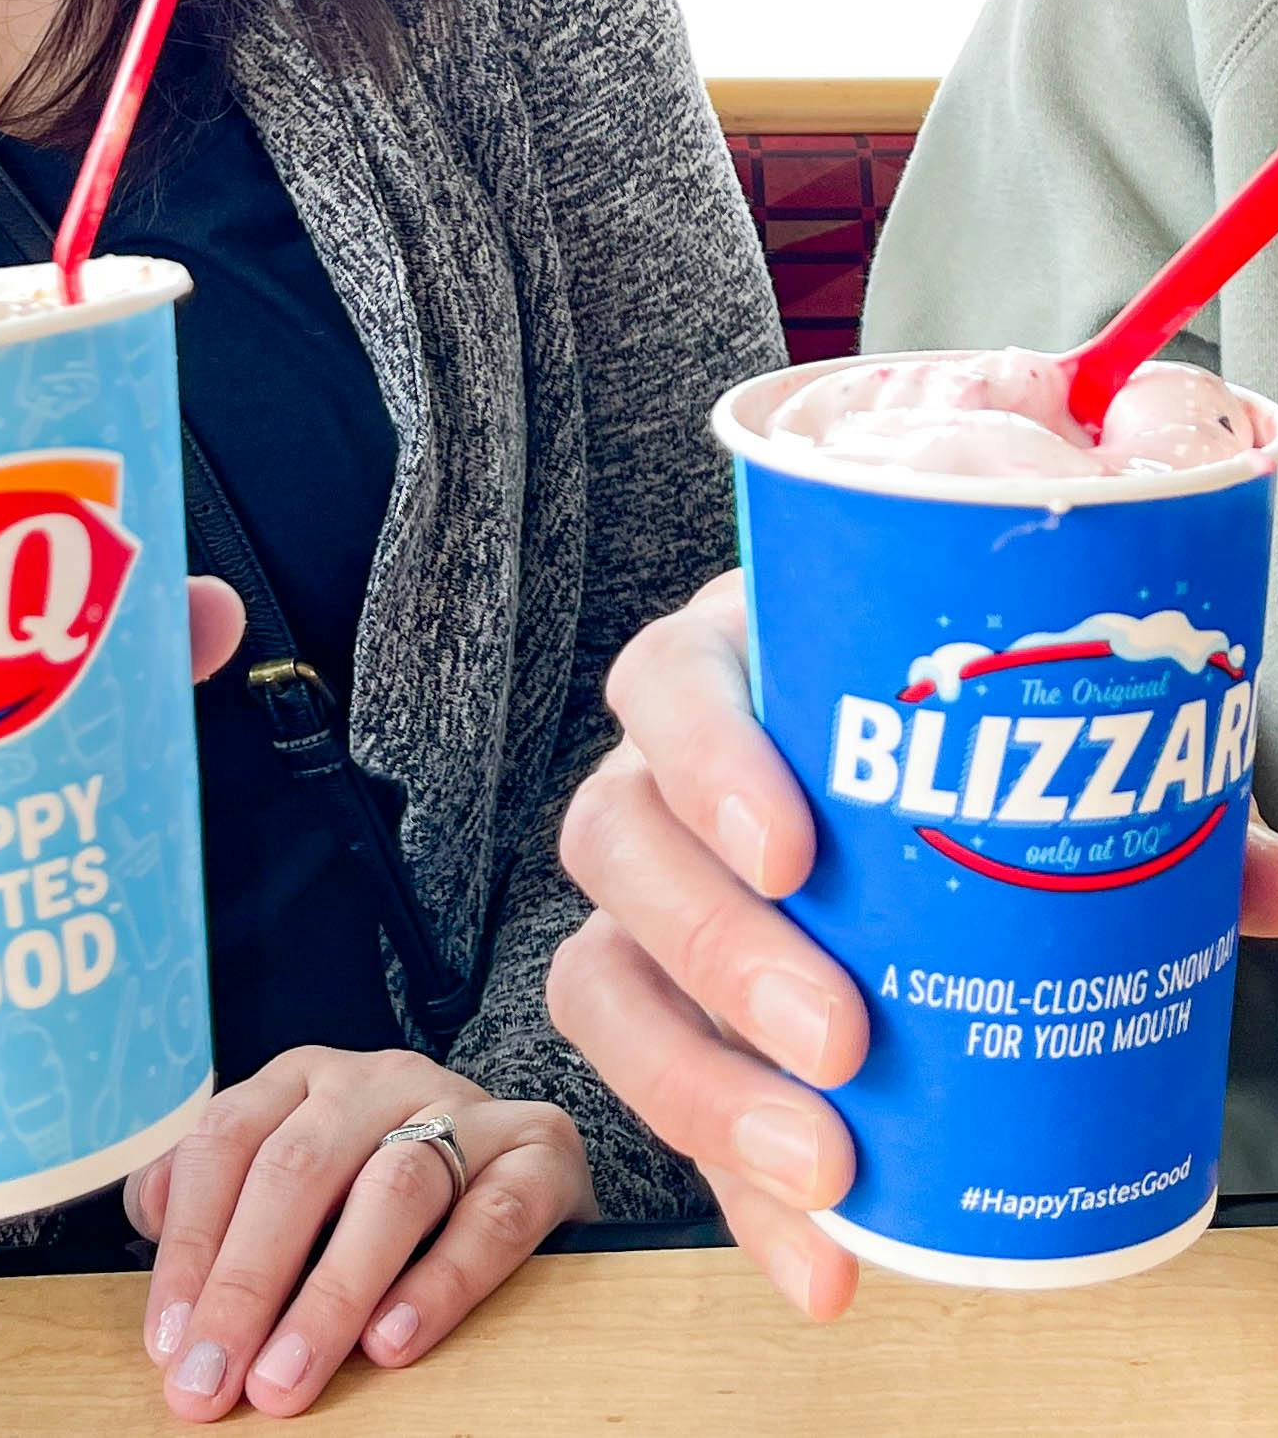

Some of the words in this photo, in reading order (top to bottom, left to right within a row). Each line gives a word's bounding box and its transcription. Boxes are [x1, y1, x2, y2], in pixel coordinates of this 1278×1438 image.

[1021, 678, 1062, 706] The
[1072, 670, 1171, 709] Original
[1025, 835, 1082, 871] only
[1088, 835, 1115, 862] at
[881, 963, 899, 999] A
[908, 967, 1149, 1016] SCHOOL-CLOSING
[1154, 942, 1214, 1000] SNOW
[967, 1020, 1021, 1060] FOR
[1034, 1020, 1105, 1060] YOUR
[1111, 997, 1193, 1053] MOUTH
[960, 1153, 1192, 1220] #HappyTastesGood
